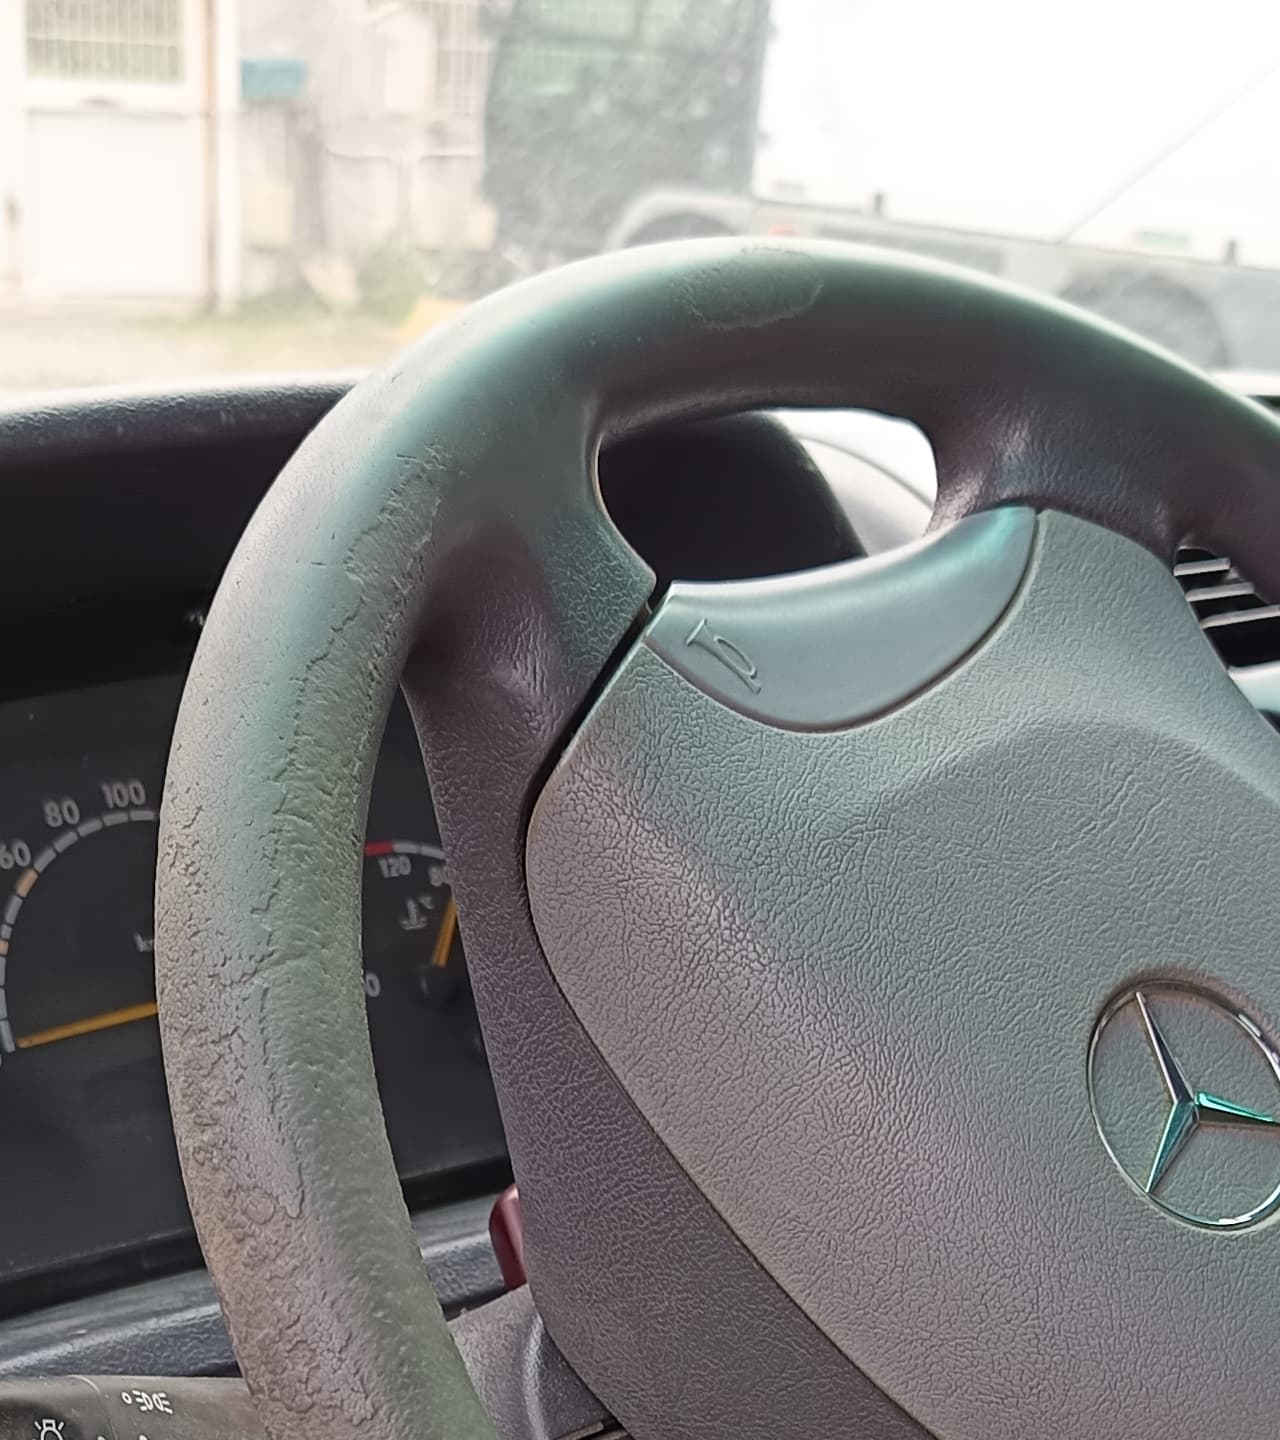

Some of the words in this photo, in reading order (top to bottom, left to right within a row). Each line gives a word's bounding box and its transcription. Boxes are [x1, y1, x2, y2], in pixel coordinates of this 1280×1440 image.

[101, 780, 146, 808] 100
[43, 798, 79, 826] 80
[378, 855, 411, 878] 120
